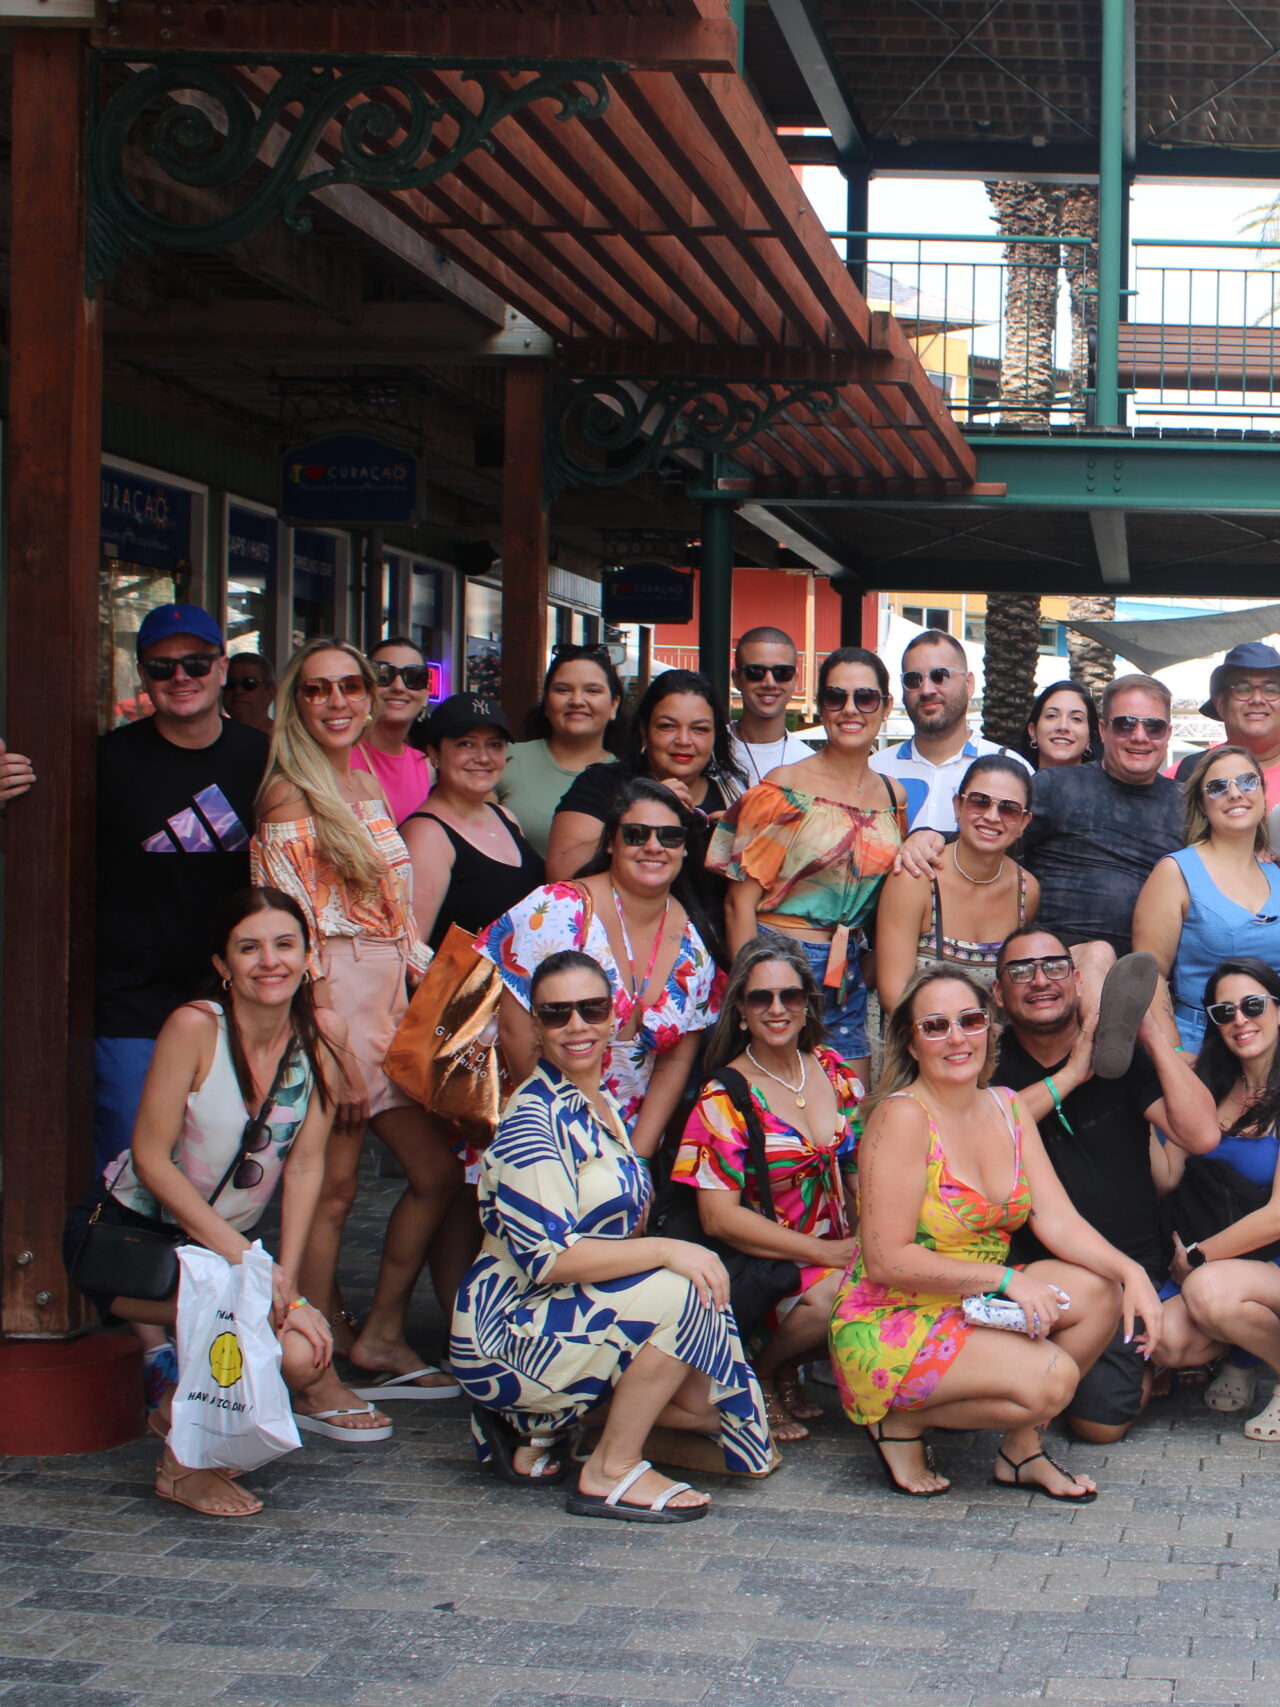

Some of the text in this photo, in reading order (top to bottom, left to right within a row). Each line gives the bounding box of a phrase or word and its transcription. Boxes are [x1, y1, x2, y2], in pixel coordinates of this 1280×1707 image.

[327, 464, 408, 482] CURAÇAO
[101, 479, 169, 526] URAÇAO
[187, 1391, 208, 1402] HAV
